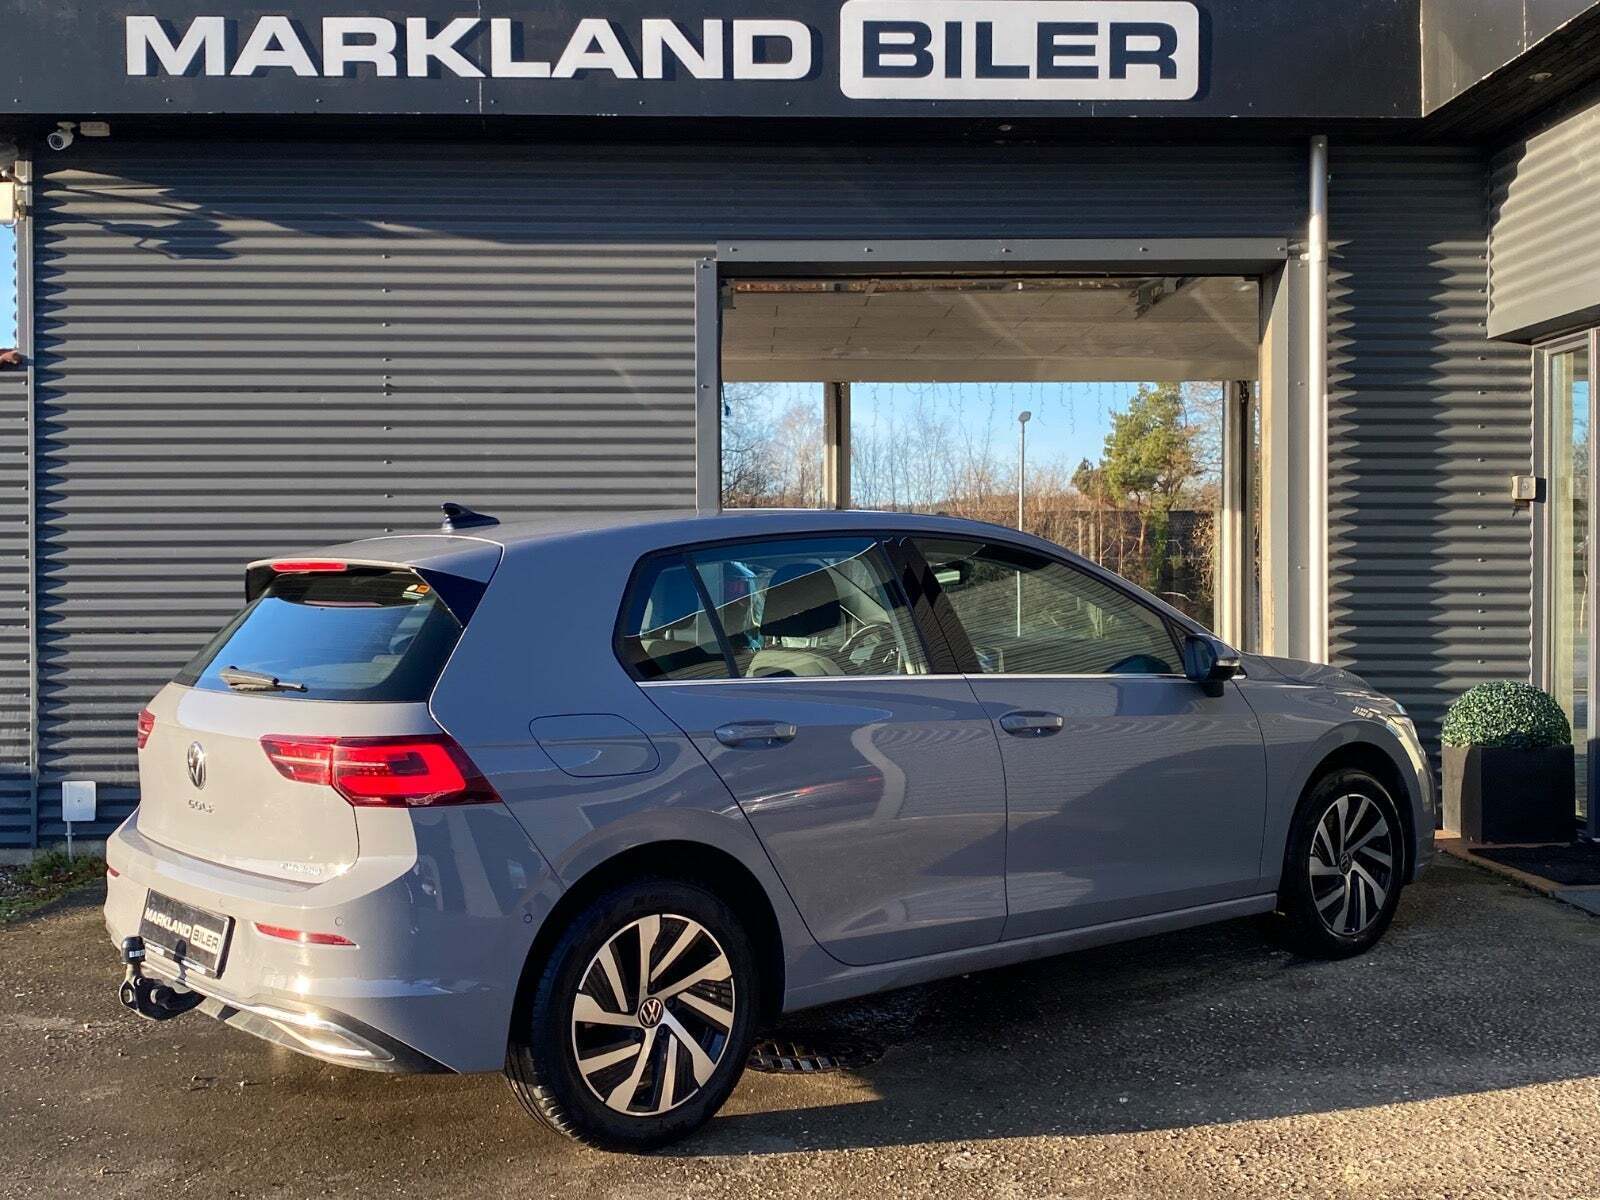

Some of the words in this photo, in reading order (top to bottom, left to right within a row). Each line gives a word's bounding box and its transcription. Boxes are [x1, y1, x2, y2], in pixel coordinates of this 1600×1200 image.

[126, 16, 811, 79] MARKLAND
[862, 20, 1178, 79] BILER
[144, 907, 192, 939] MARKLAND
[192, 928, 219, 951] BILER
